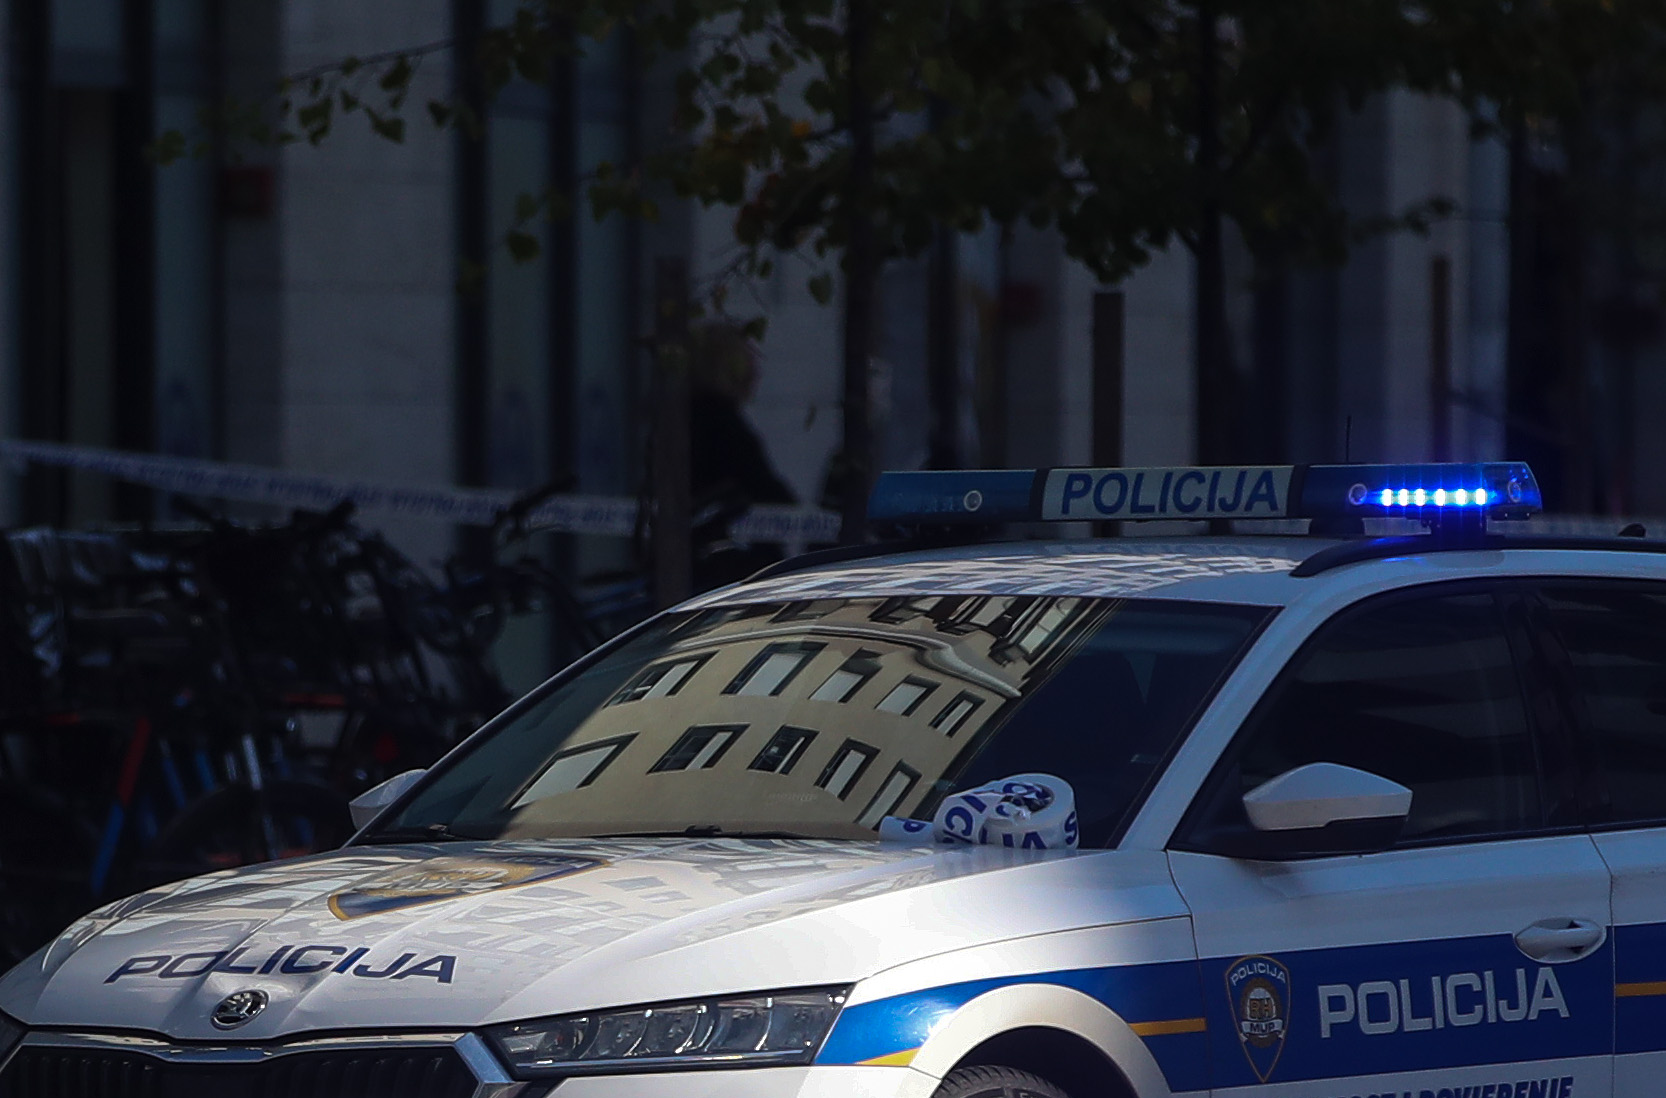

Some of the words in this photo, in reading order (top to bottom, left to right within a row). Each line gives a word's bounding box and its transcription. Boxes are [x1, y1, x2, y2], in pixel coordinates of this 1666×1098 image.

[1061, 470, 1280, 516] POLICIJA
[103, 943, 459, 984] POLICIJA
[1230, 962, 1287, 986] POLICIJA
[1317, 966, 1571, 1039] POLICIJA
[1249, 1021, 1277, 1034] MUP
